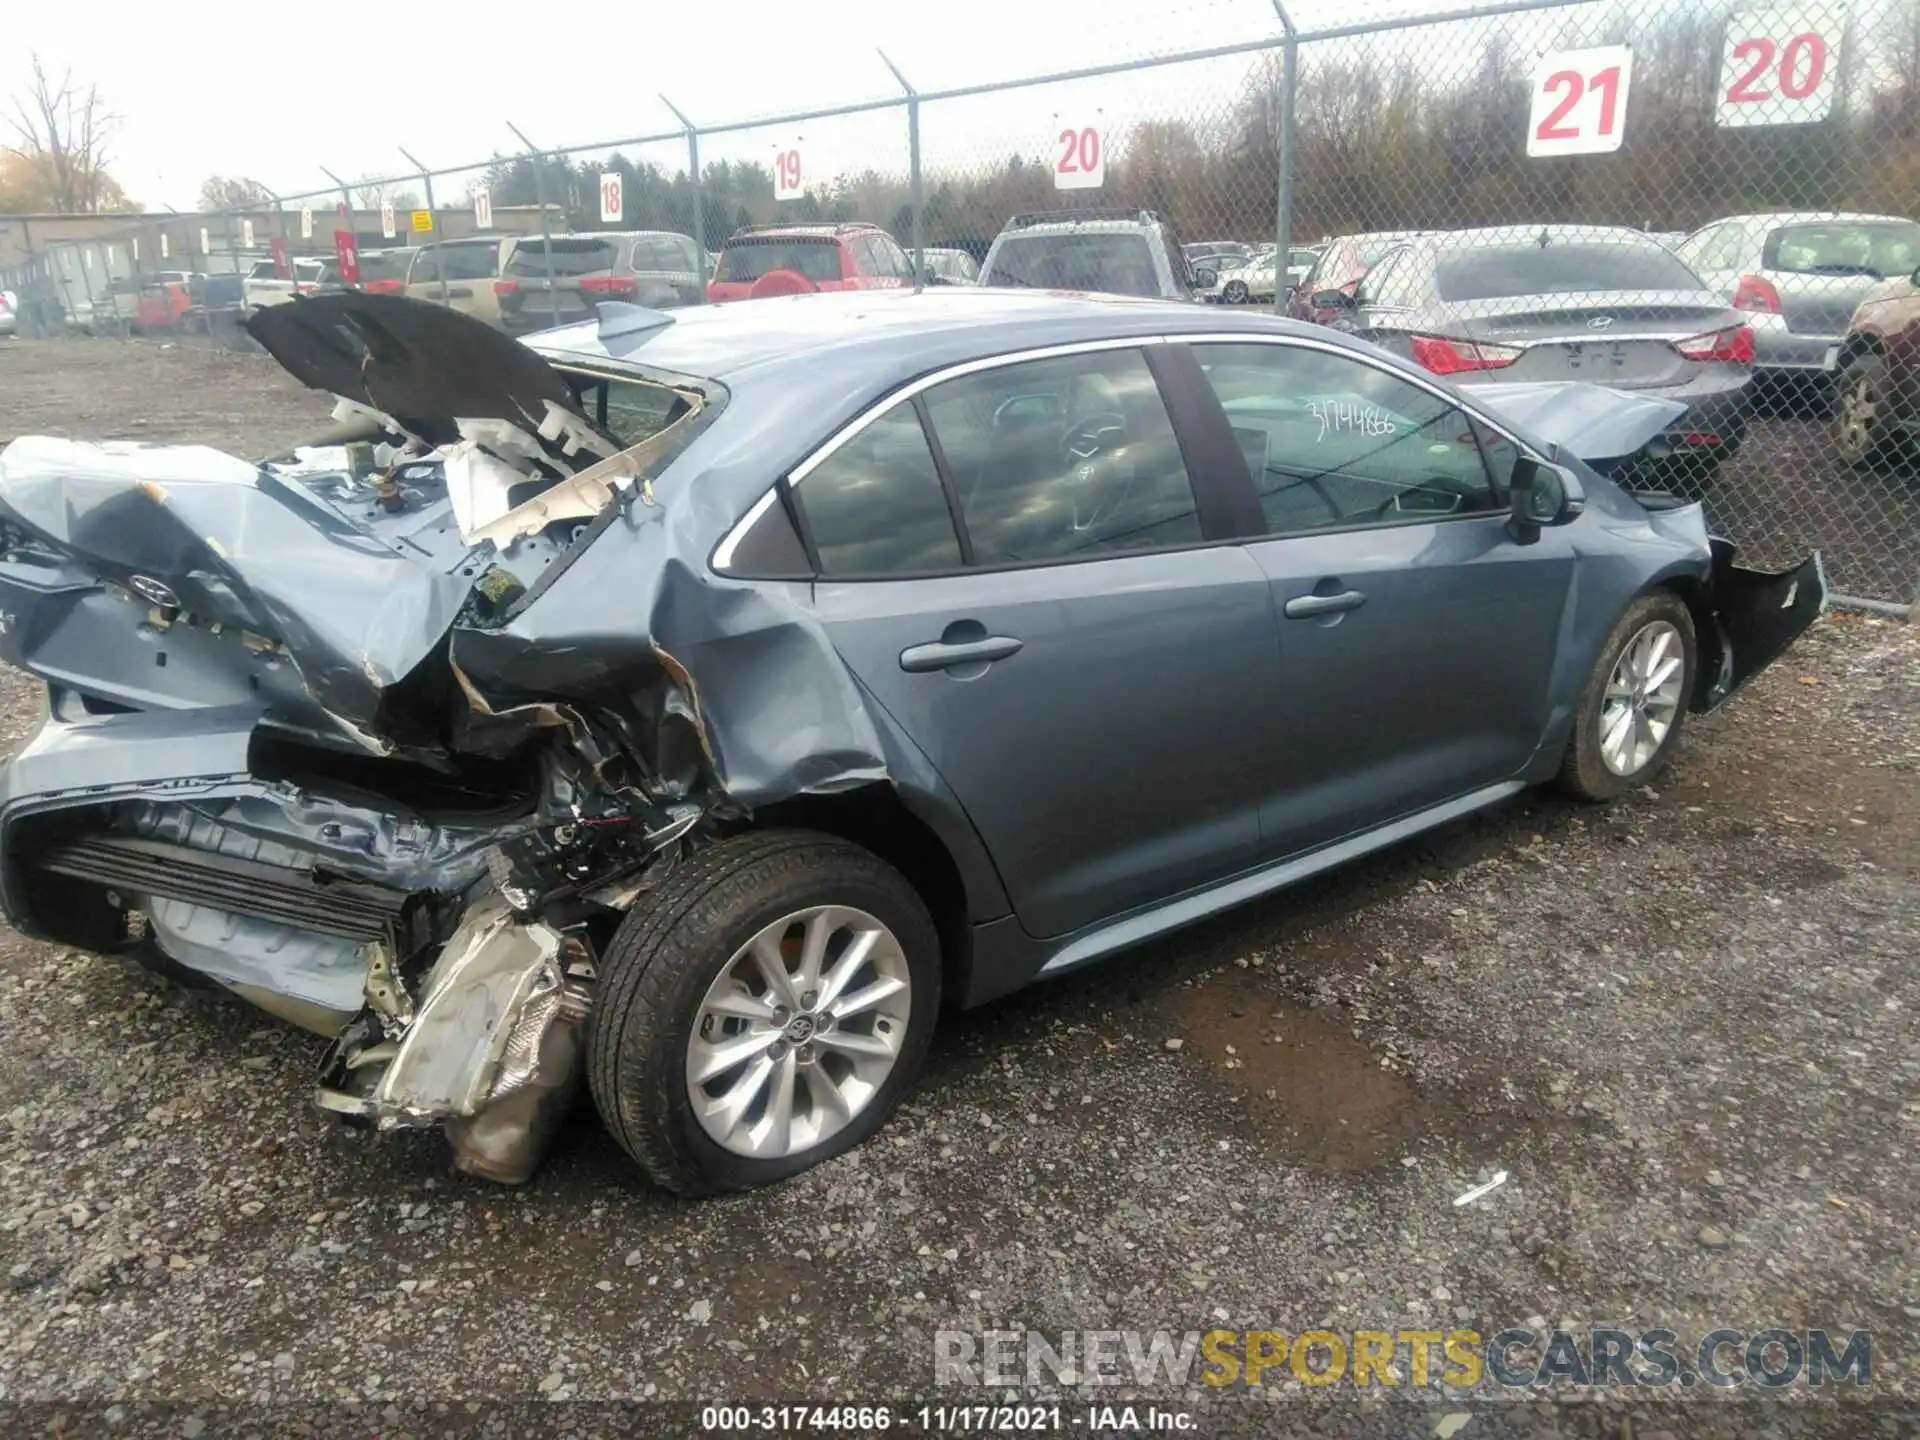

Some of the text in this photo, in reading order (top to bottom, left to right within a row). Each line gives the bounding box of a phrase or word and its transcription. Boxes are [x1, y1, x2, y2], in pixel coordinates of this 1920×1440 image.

[1726, 32, 1828, 104] 20
[1535, 66, 1620, 141] 21
[776, 149, 801, 191] 19
[1057, 127, 1100, 173] 20
[602, 181, 620, 214] 18
[1303, 399, 1396, 442] 31744866
